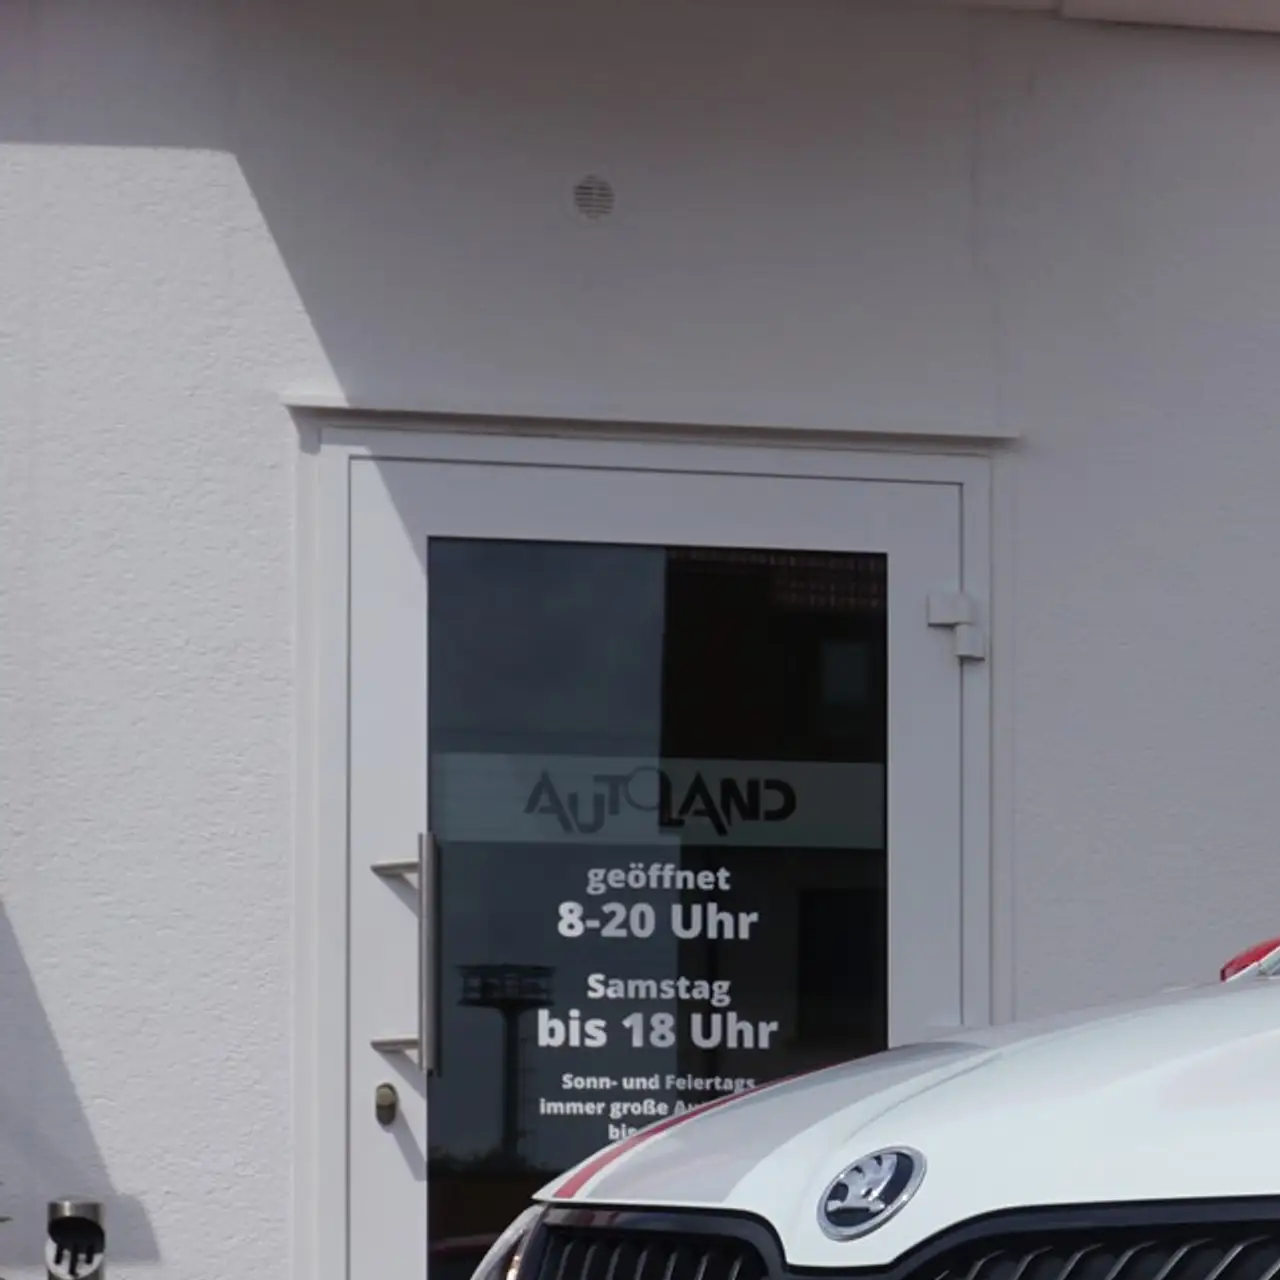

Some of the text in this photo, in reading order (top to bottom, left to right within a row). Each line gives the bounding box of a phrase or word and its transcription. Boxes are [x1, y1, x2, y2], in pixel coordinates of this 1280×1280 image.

[586, 863, 731, 895] geöffnet
[556, 901, 758, 940] 8-20 Uhr
[586, 973, 731, 1006] Samstag
[537, 1009, 779, 1050] bis 18 Uhr
[561, 1073, 756, 1093] Sonn- und Feiertags
[609, 1098, 669, 1119] große
